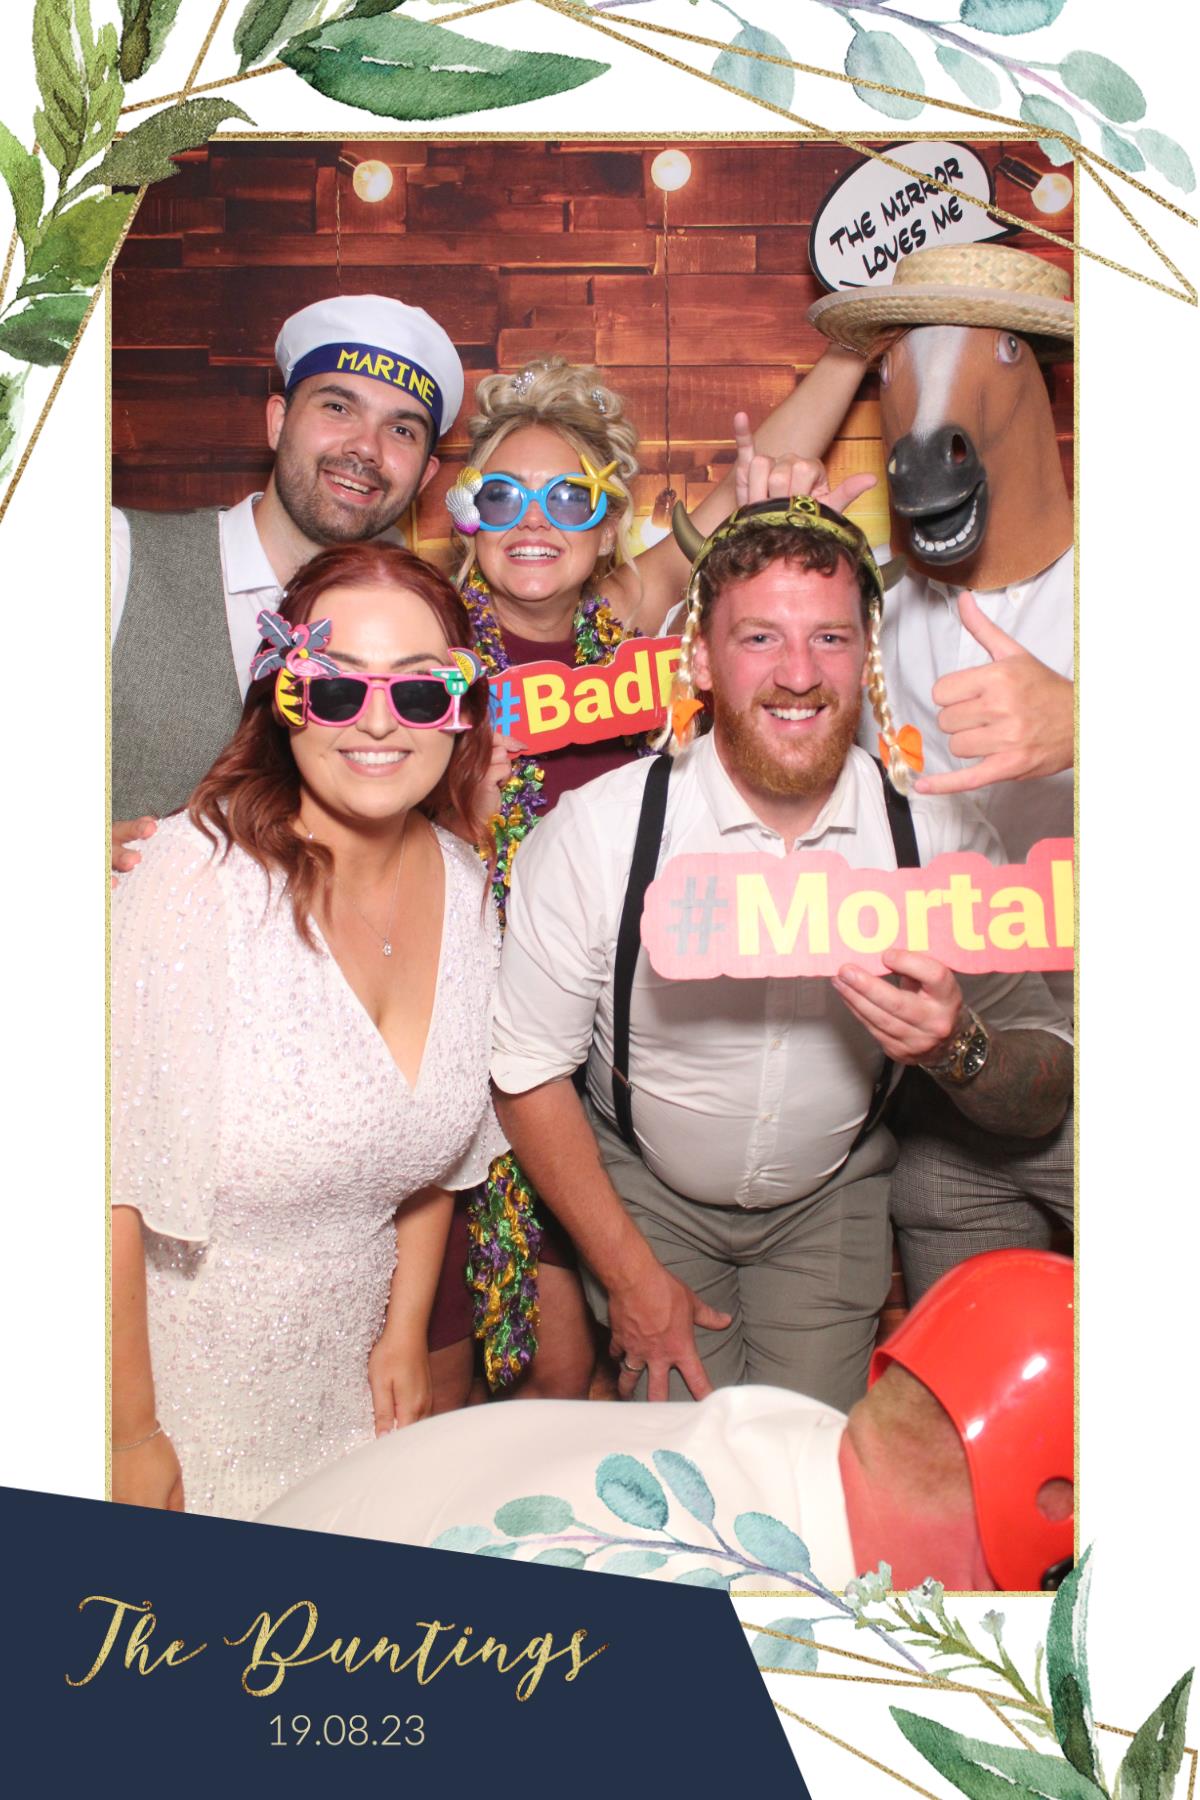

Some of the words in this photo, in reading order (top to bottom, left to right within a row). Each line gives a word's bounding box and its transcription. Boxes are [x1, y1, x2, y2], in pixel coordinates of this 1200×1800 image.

[829, 211, 876, 255] THE
[881, 158, 963, 226] MIRROR
[862, 219, 926, 279] LOVES
[931, 196, 963, 234] ME
[337, 349, 435, 407] MARINE
